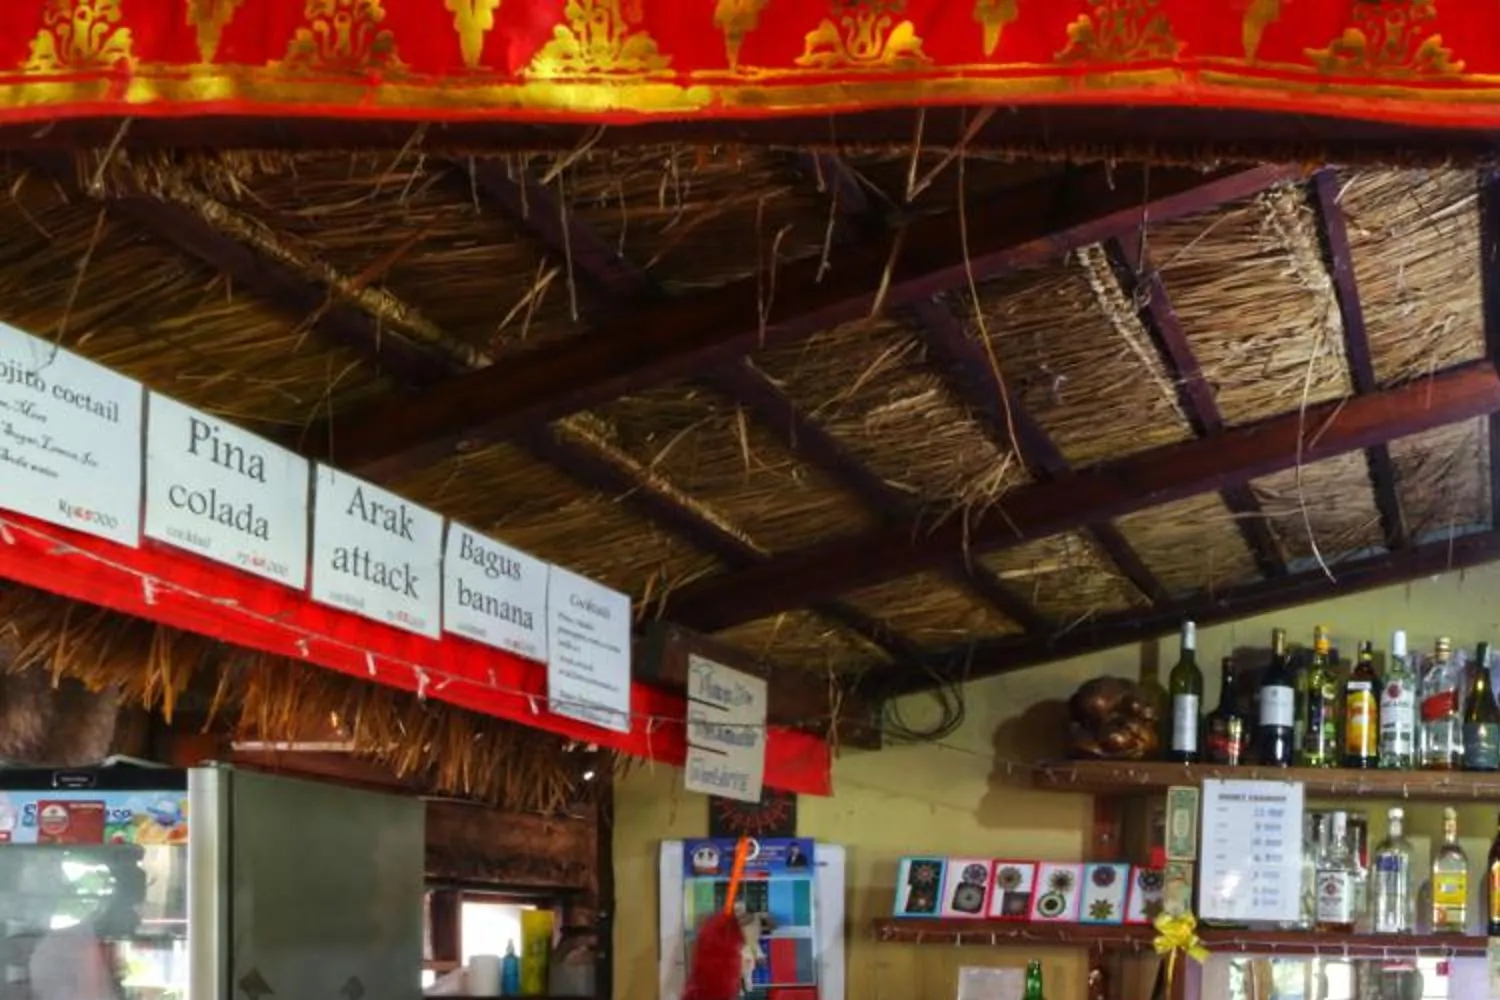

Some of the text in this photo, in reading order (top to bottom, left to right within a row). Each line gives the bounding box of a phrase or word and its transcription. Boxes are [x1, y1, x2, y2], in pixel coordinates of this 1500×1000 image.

[52, 384, 119, 423] coctail
[188, 416, 267, 484] Pina
[168, 484, 270, 541] colada
[345, 486, 415, 542] Arak
[331, 546, 421, 600] attack
[459, 532, 522, 581] Bagus
[457, 577, 534, 631] banana
